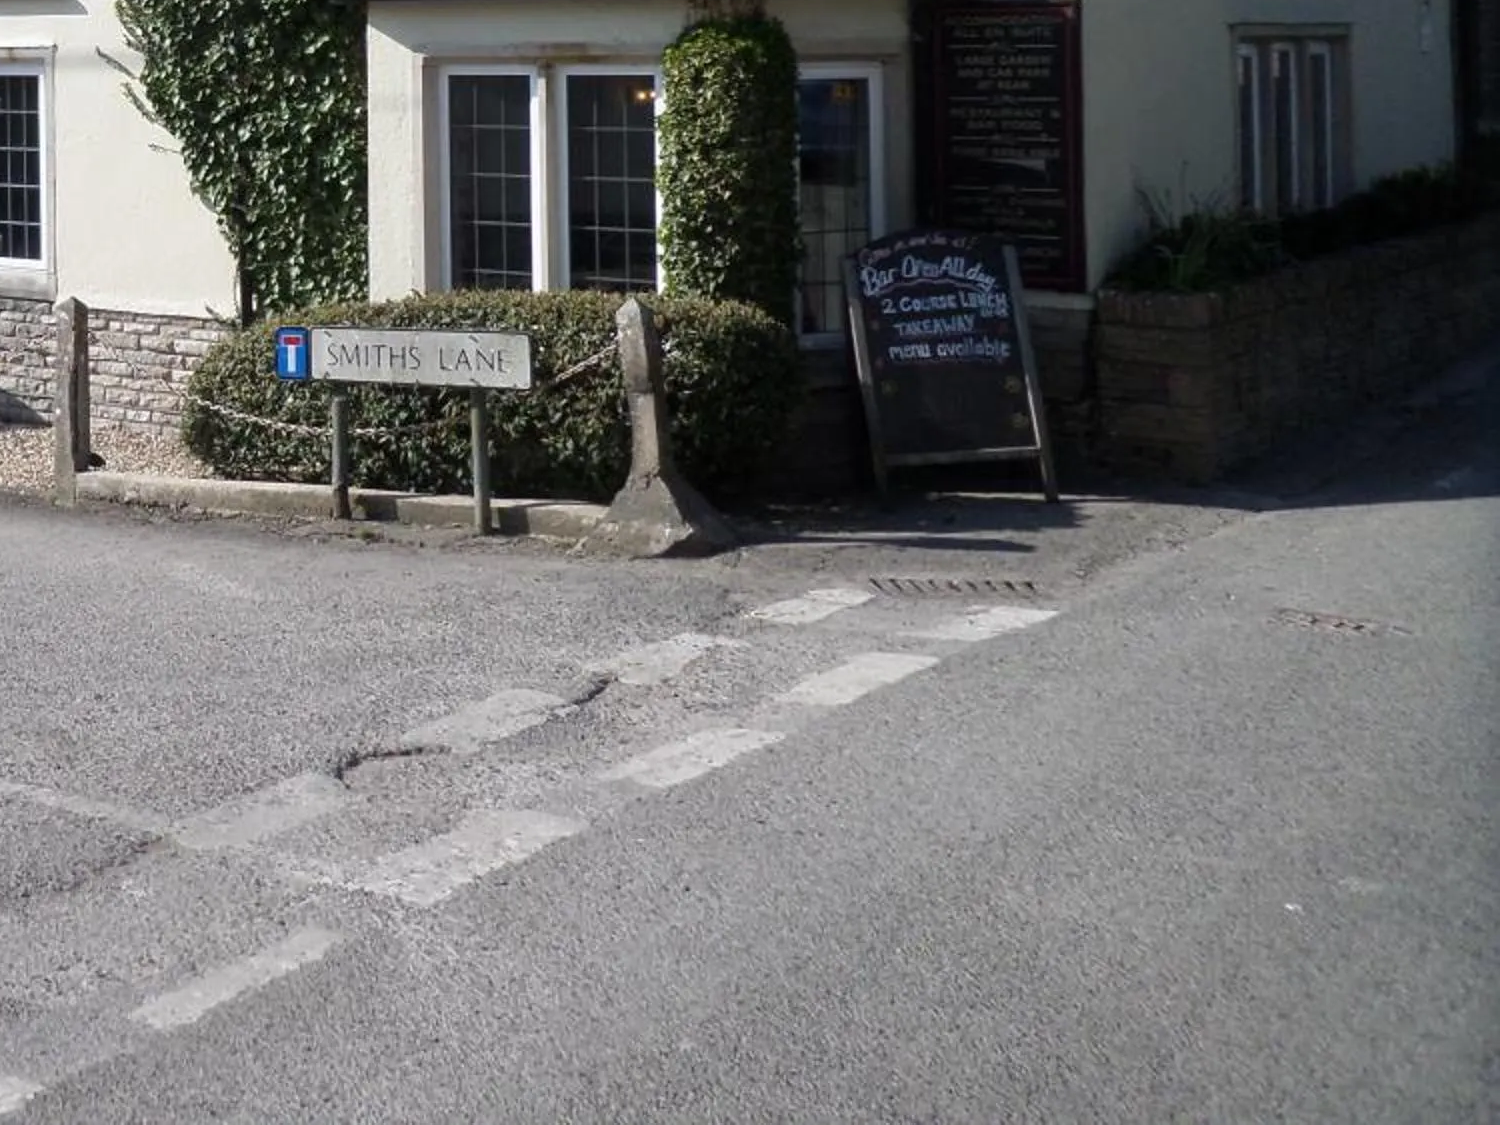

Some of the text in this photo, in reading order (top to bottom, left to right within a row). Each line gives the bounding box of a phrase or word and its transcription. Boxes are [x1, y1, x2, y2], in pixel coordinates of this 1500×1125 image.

[860, 266, 899, 297] Bar
[940, 256, 965, 278] All
[881, 298, 897, 314] 2
[959, 290, 1008, 309] LUNCH
[892, 314, 976, 336] TAKEAWAY
[327, 342, 513, 373] SMITHS LANE
[888, 335, 1011, 360] menu available
